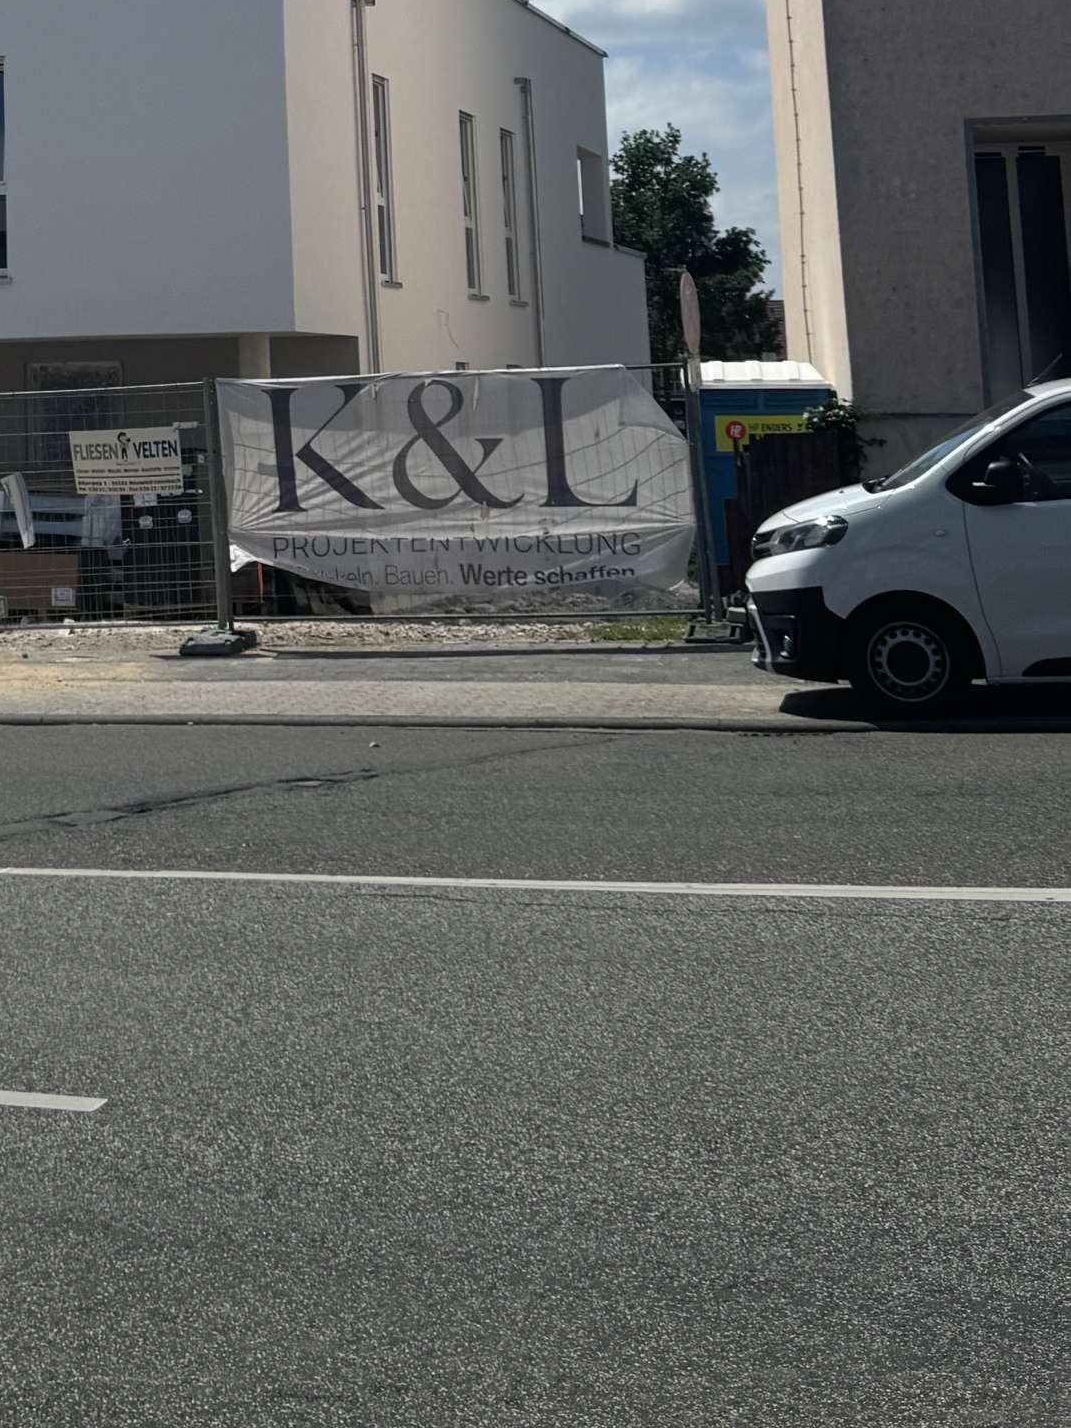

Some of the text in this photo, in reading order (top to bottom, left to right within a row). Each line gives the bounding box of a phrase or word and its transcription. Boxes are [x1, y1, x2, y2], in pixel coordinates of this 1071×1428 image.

[72, 439, 179, 461] FLIESEN VELTEN
[273, 532, 641, 559] PROJEKTENTWICKLUNG
[384, 564, 454, 586] Bauen.
[459, 563, 528, 586] Werte
